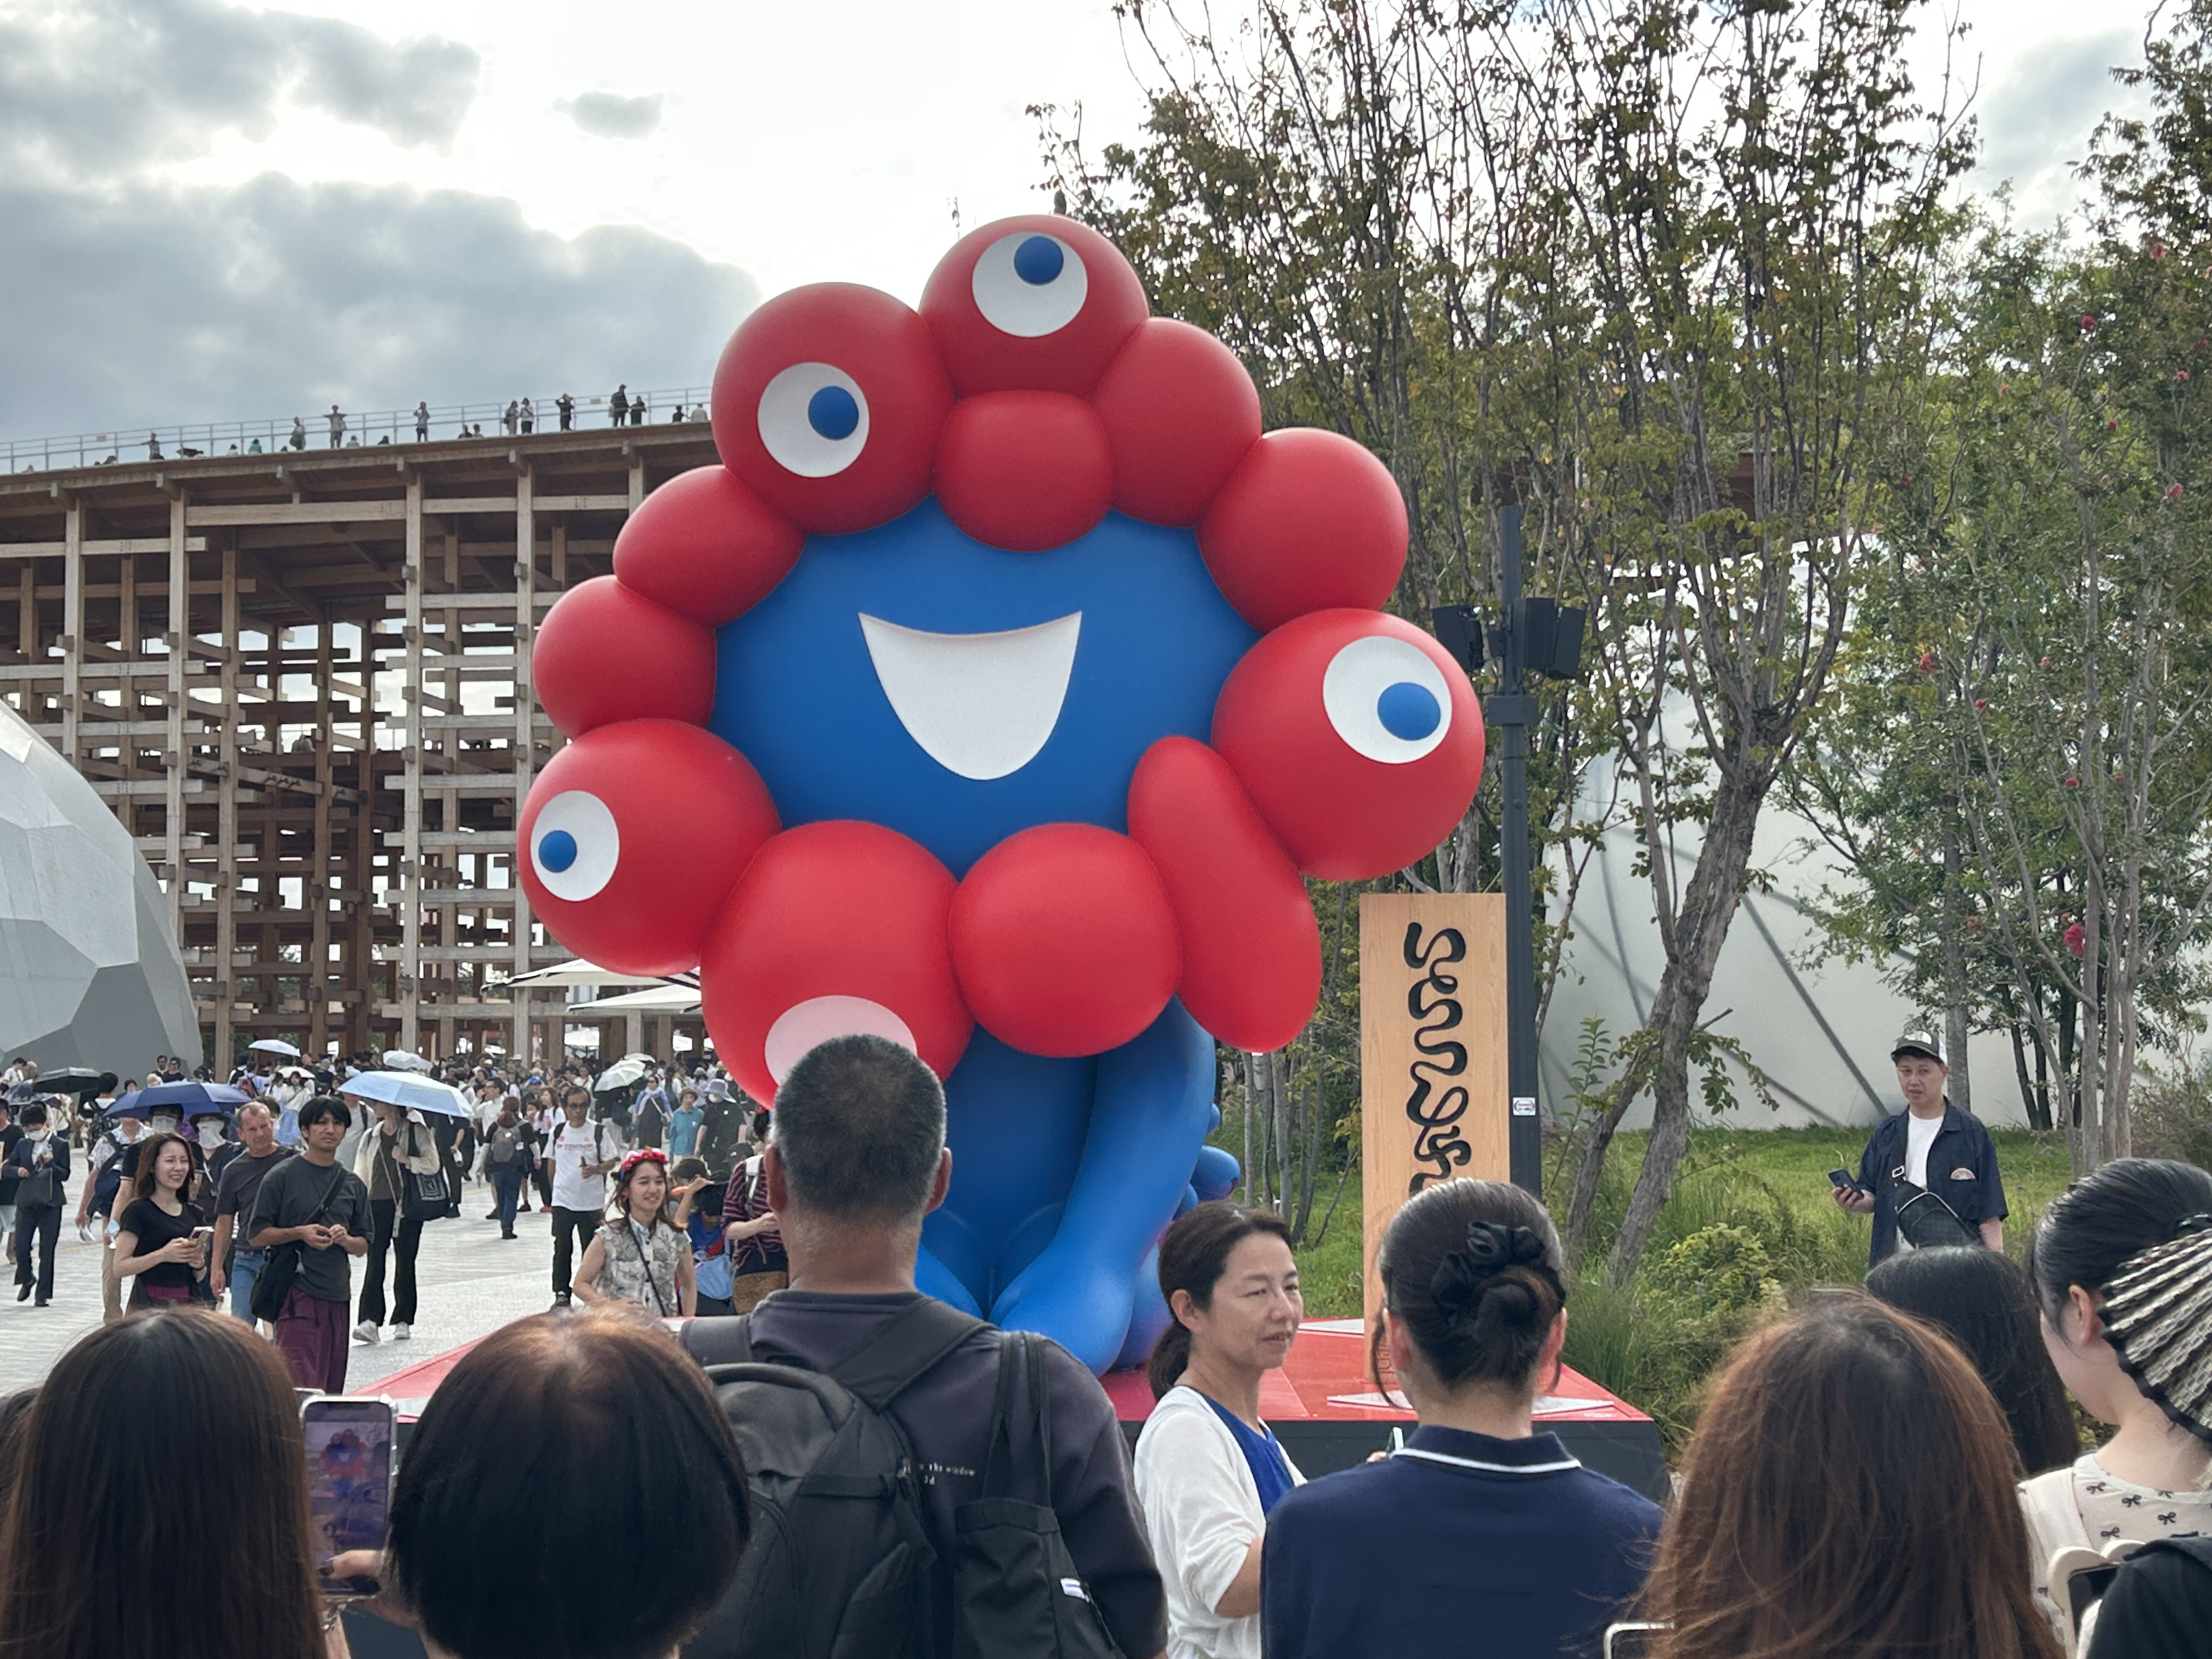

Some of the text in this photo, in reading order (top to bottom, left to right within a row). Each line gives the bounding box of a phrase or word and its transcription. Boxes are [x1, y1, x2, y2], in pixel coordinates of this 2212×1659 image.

[1404, 922, 1471, 1194] いらっしゃ
